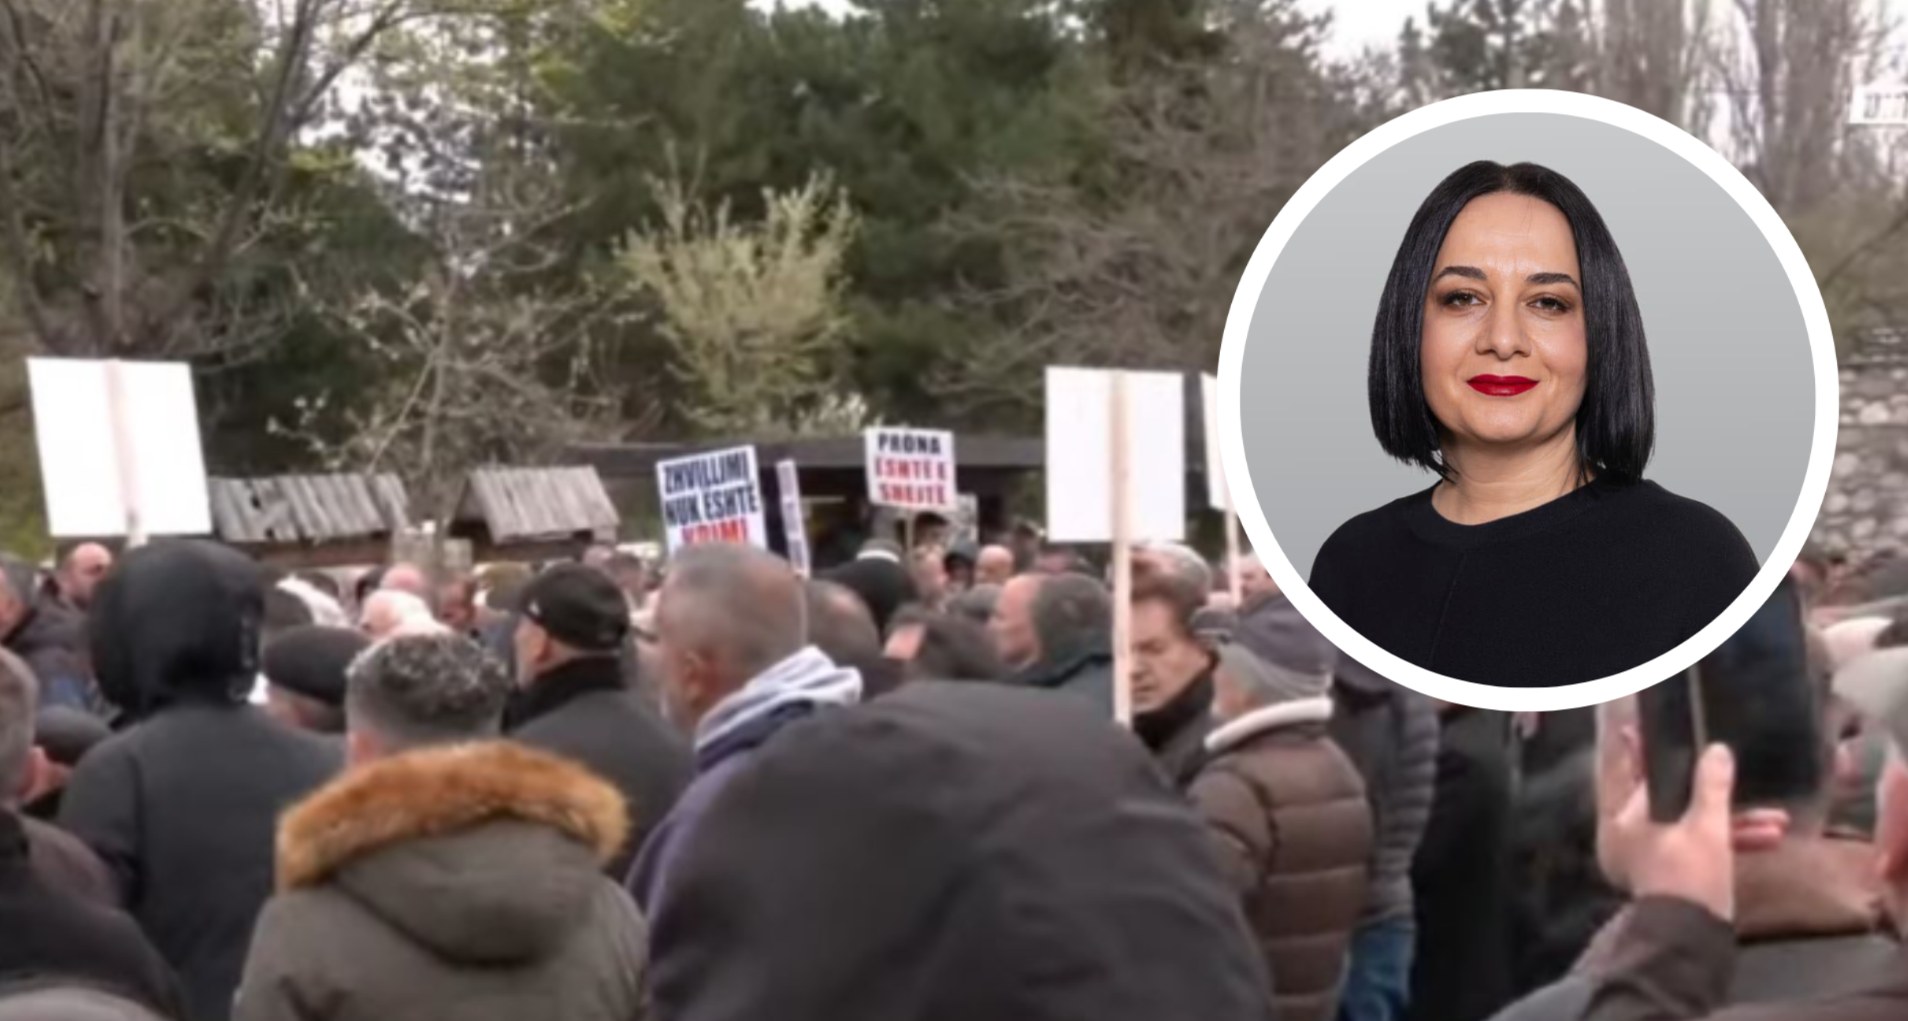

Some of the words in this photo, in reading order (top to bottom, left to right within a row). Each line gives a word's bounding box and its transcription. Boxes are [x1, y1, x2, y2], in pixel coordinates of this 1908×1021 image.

[878, 433, 941, 454] PRONA
[664, 452, 749, 495] ZHVILLIMI
[665, 493, 702, 527] NUK
